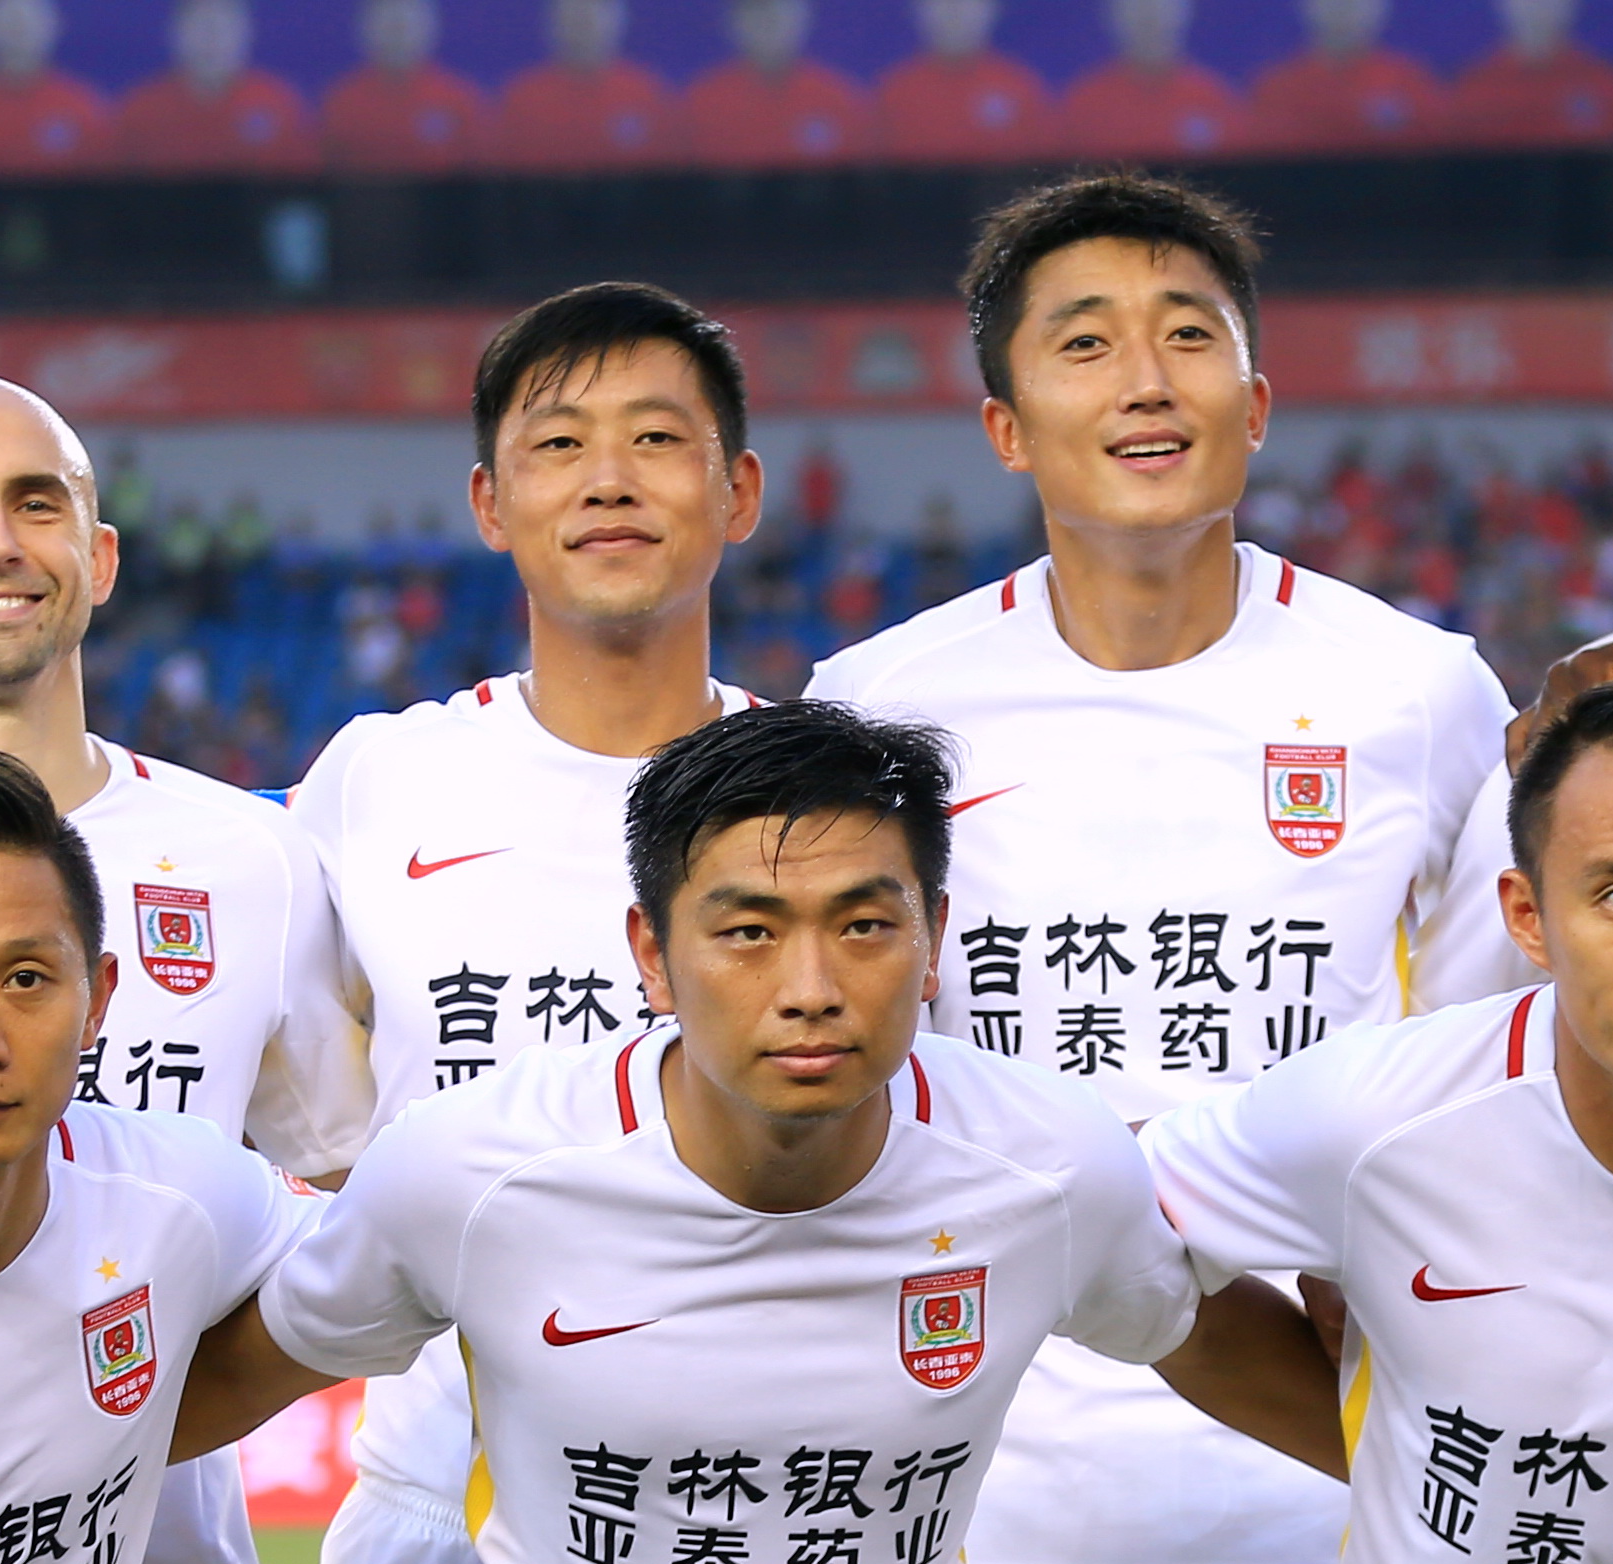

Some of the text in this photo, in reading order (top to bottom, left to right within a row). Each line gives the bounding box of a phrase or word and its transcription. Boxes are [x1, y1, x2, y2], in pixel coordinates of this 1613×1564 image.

[961, 907, 1332, 997] 吉林银行
[429, 961, 678, 1046] 吉林
[970, 1004, 1327, 1075] 亚泰药业
[116, 1390, 142, 1410] 1996
[929, 1366, 961, 1381] 1996
[563, 1440, 972, 1521] 吉林银行
